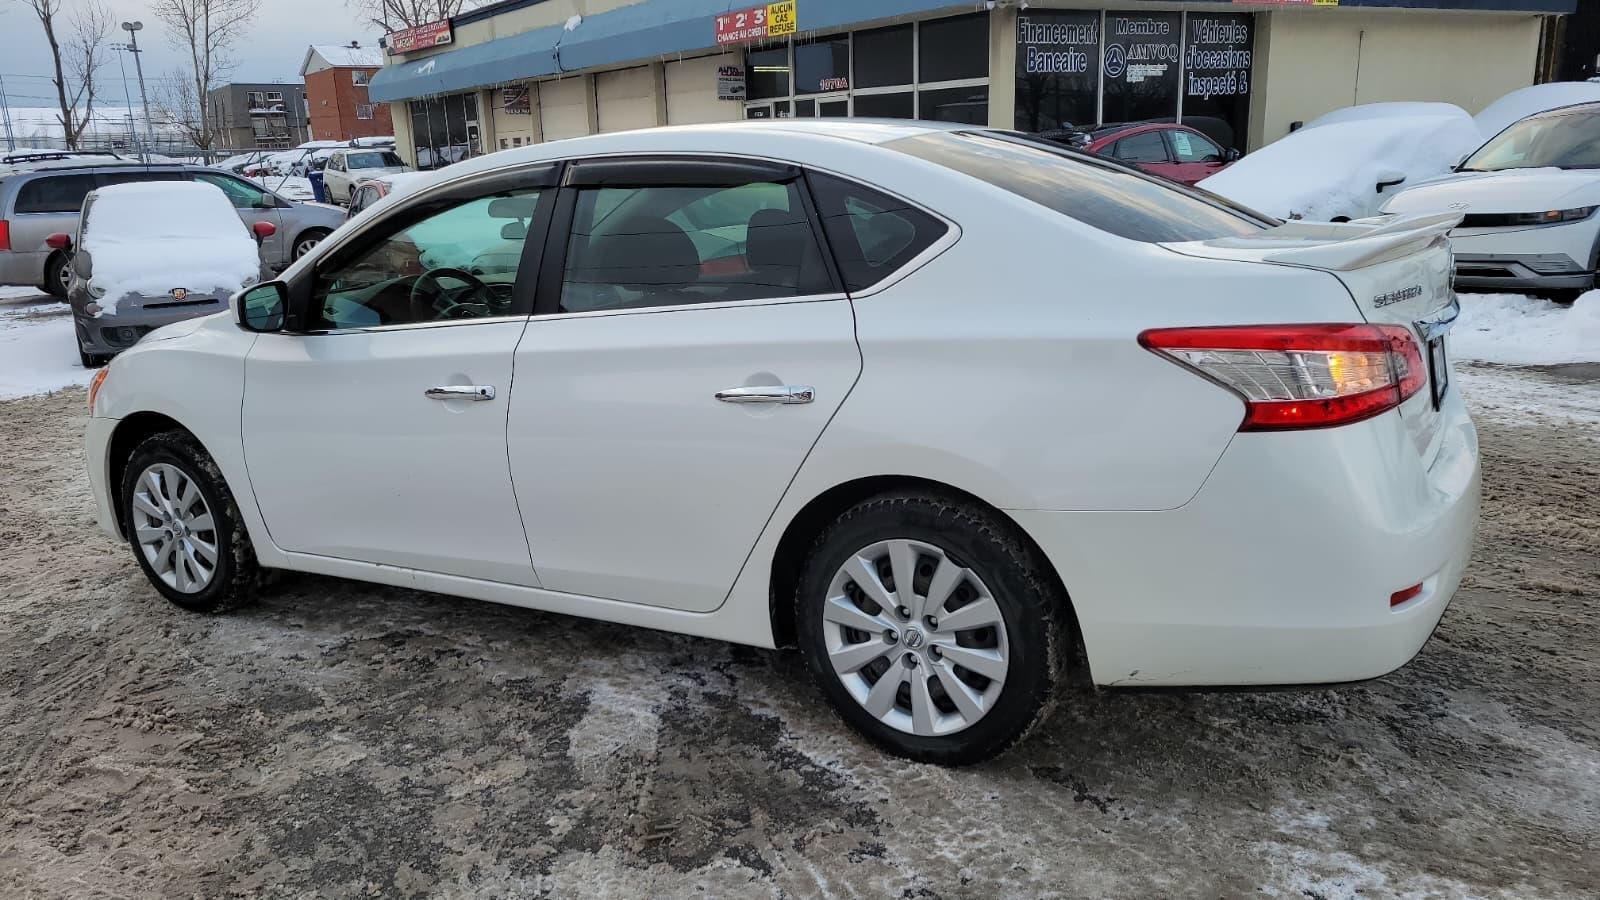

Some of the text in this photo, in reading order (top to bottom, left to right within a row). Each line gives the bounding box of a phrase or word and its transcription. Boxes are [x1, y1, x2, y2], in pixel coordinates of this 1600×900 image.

[771, 5, 793, 15] AUCUN
[775, 14, 788, 24] CAS
[717, 31, 739, 42] CHANCE
[740, 29, 747, 40] AU
[1016, 17, 1098, 44] Financement
[1115, 18, 1169, 35] Membre
[1192, 19, 1248, 44] Véhicules
[1026, 47, 1088, 73] Bancaire
[1126, 43, 1179, 62] AMVOQ
[1184, 46, 1250, 69] d'occasions
[1187, 72, 1237, 100] inspecté
[1239, 71, 1248, 94] &
